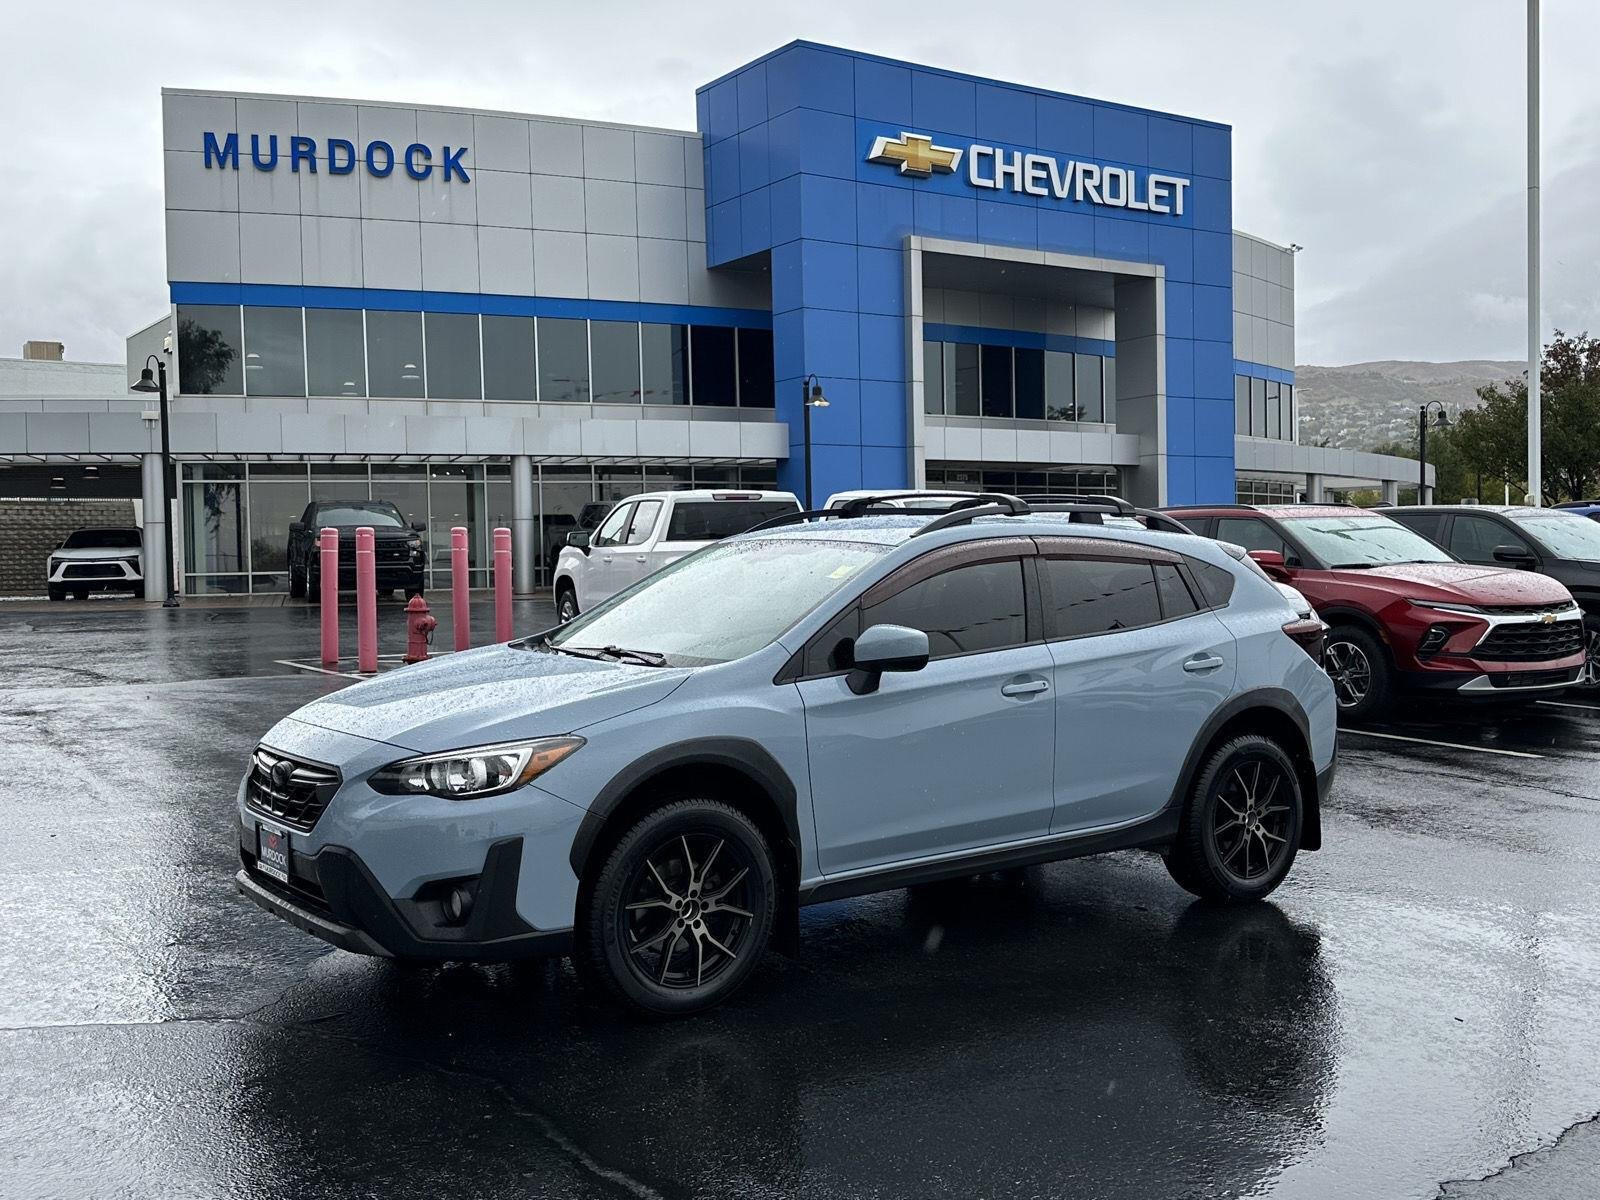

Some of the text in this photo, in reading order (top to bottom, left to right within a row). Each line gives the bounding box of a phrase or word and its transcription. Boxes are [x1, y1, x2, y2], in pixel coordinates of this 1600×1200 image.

[203, 131, 471, 183] MURDOCK
[968, 144, 1190, 215] CHEVROLET
[261, 845, 287, 867] MURDOCK
